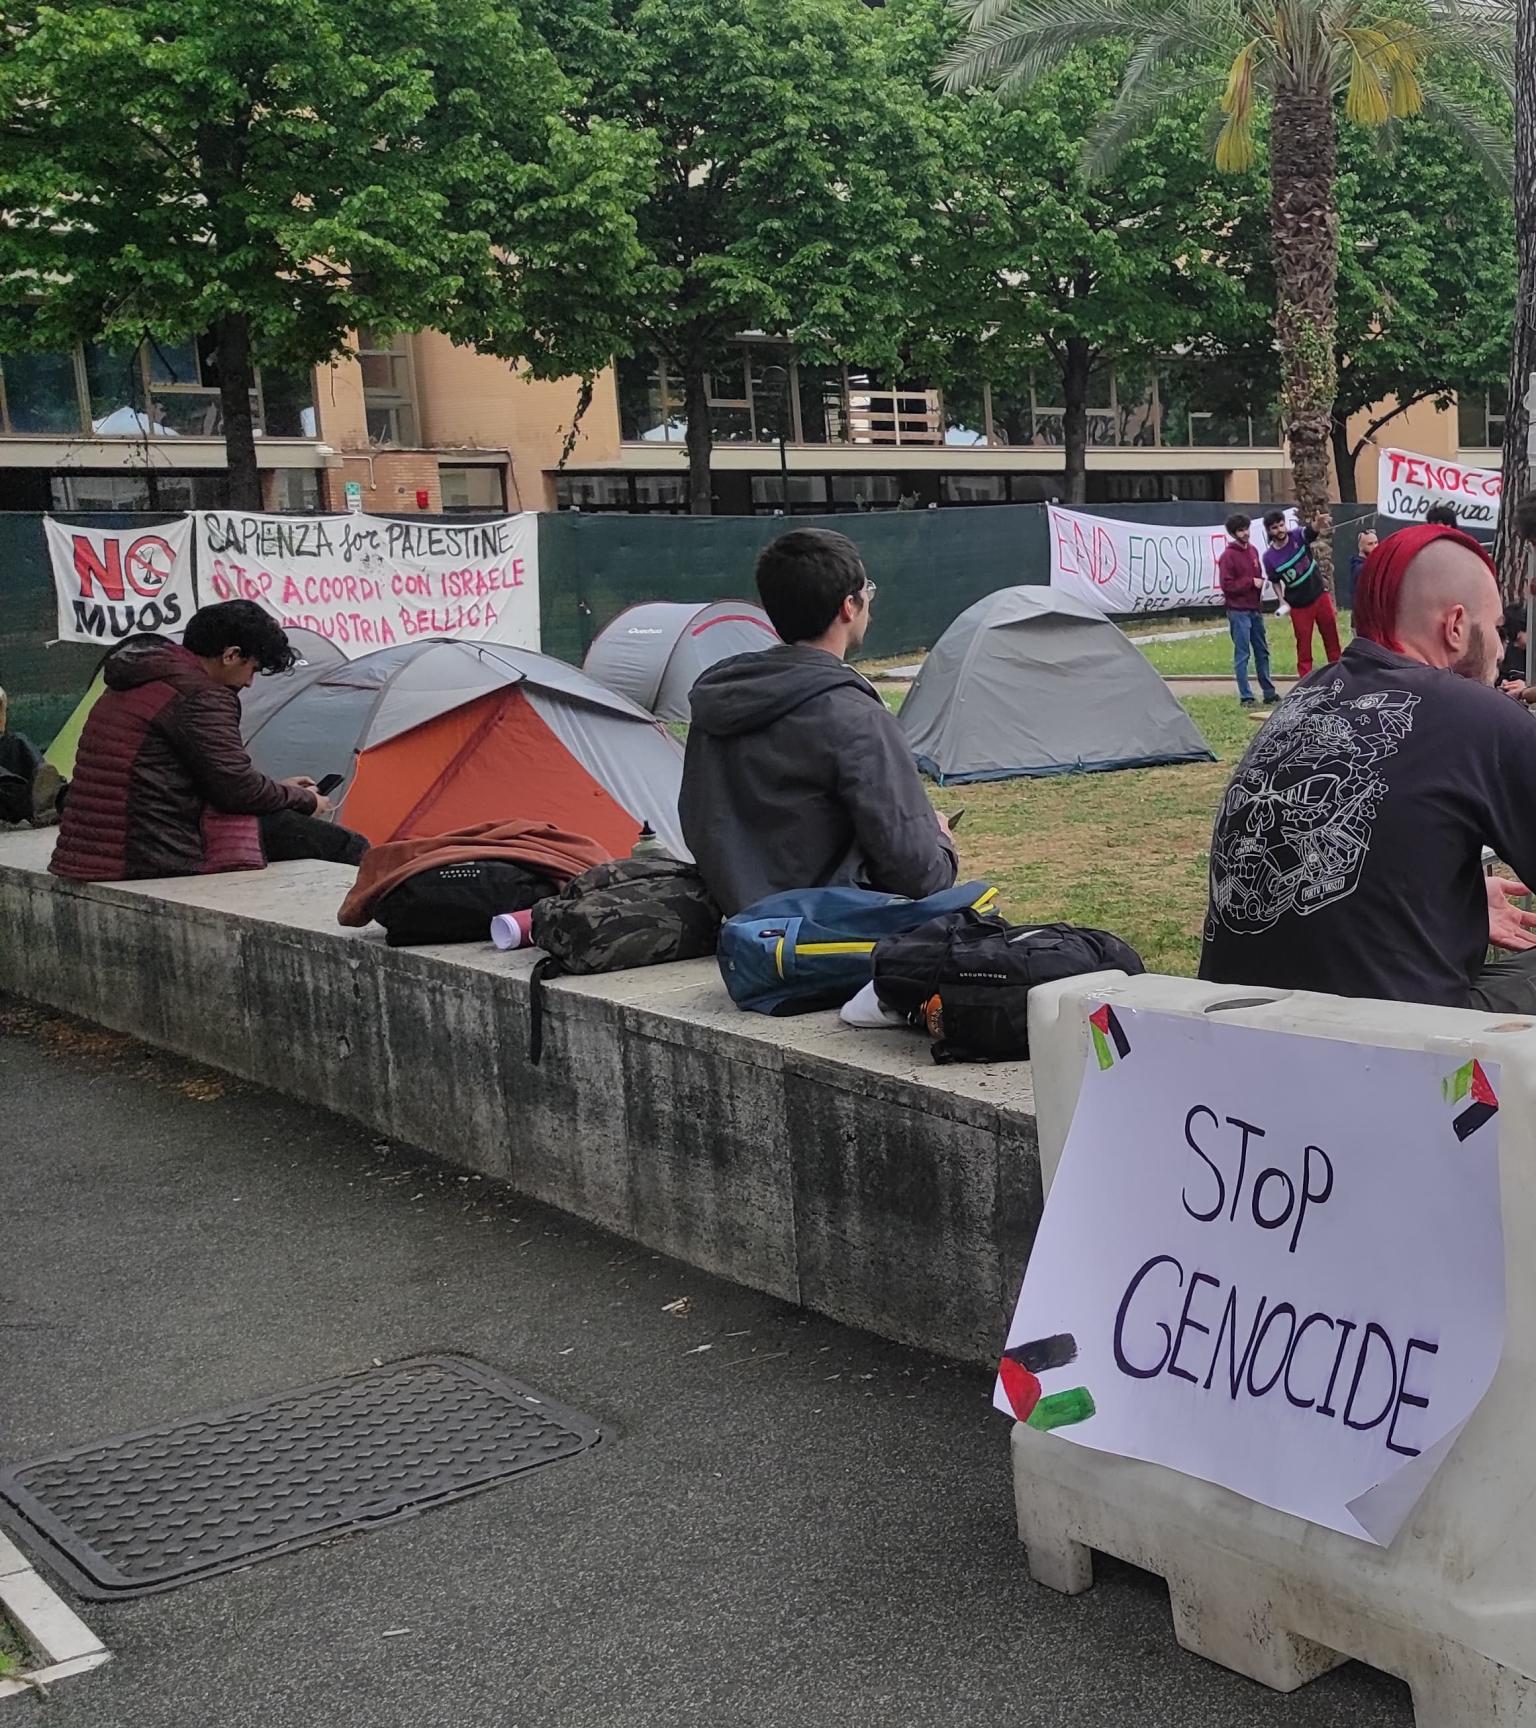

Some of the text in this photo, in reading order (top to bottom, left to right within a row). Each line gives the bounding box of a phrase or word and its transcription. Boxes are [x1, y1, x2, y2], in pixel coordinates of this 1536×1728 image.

[204, 513, 514, 563] SAPIENZA for PALESTINE
[1053, 512, 1117, 584] END
[212, 558, 525, 606] STOP ACCORDI CON ISRAELE
[72, 593, 182, 638] MUOS
[400, 601, 498, 637] BELLICA
[1113, 1254, 1439, 1456] GENOCIDE
